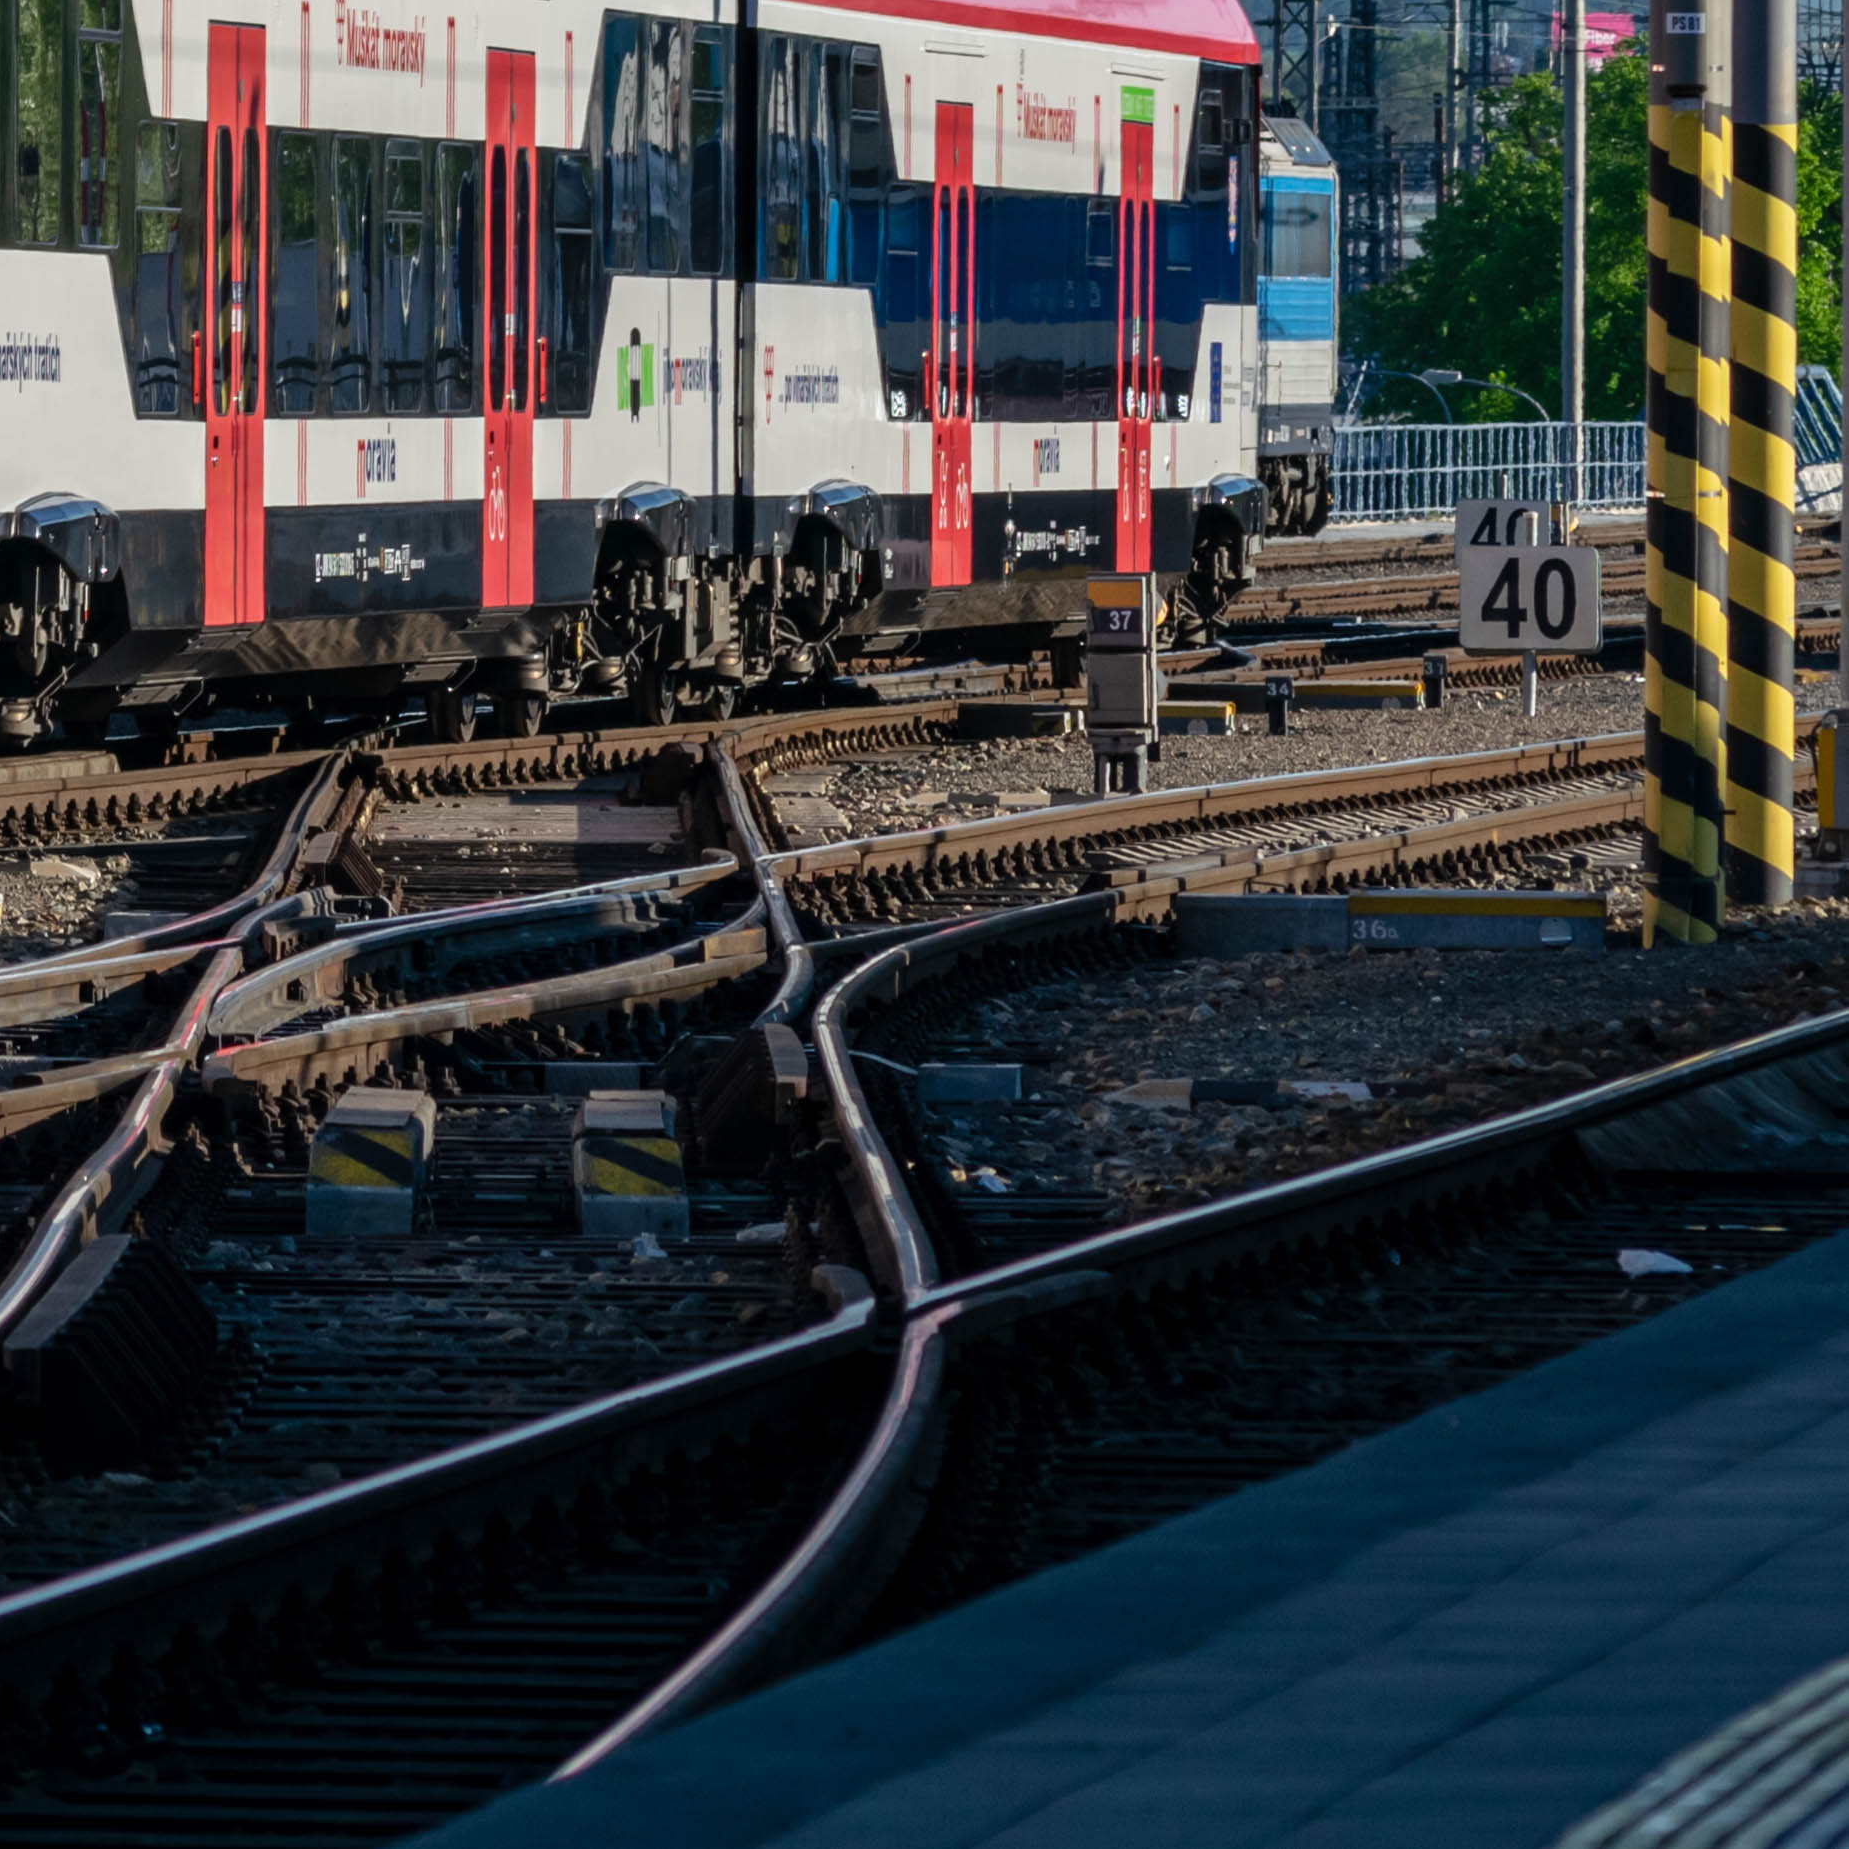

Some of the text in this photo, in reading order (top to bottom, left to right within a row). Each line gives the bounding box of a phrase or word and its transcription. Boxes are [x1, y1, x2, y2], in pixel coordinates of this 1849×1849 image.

[357, 422, 397, 499] moravia
[1108, 609, 1133, 631] 37
[1481, 557, 1577, 640] 40
